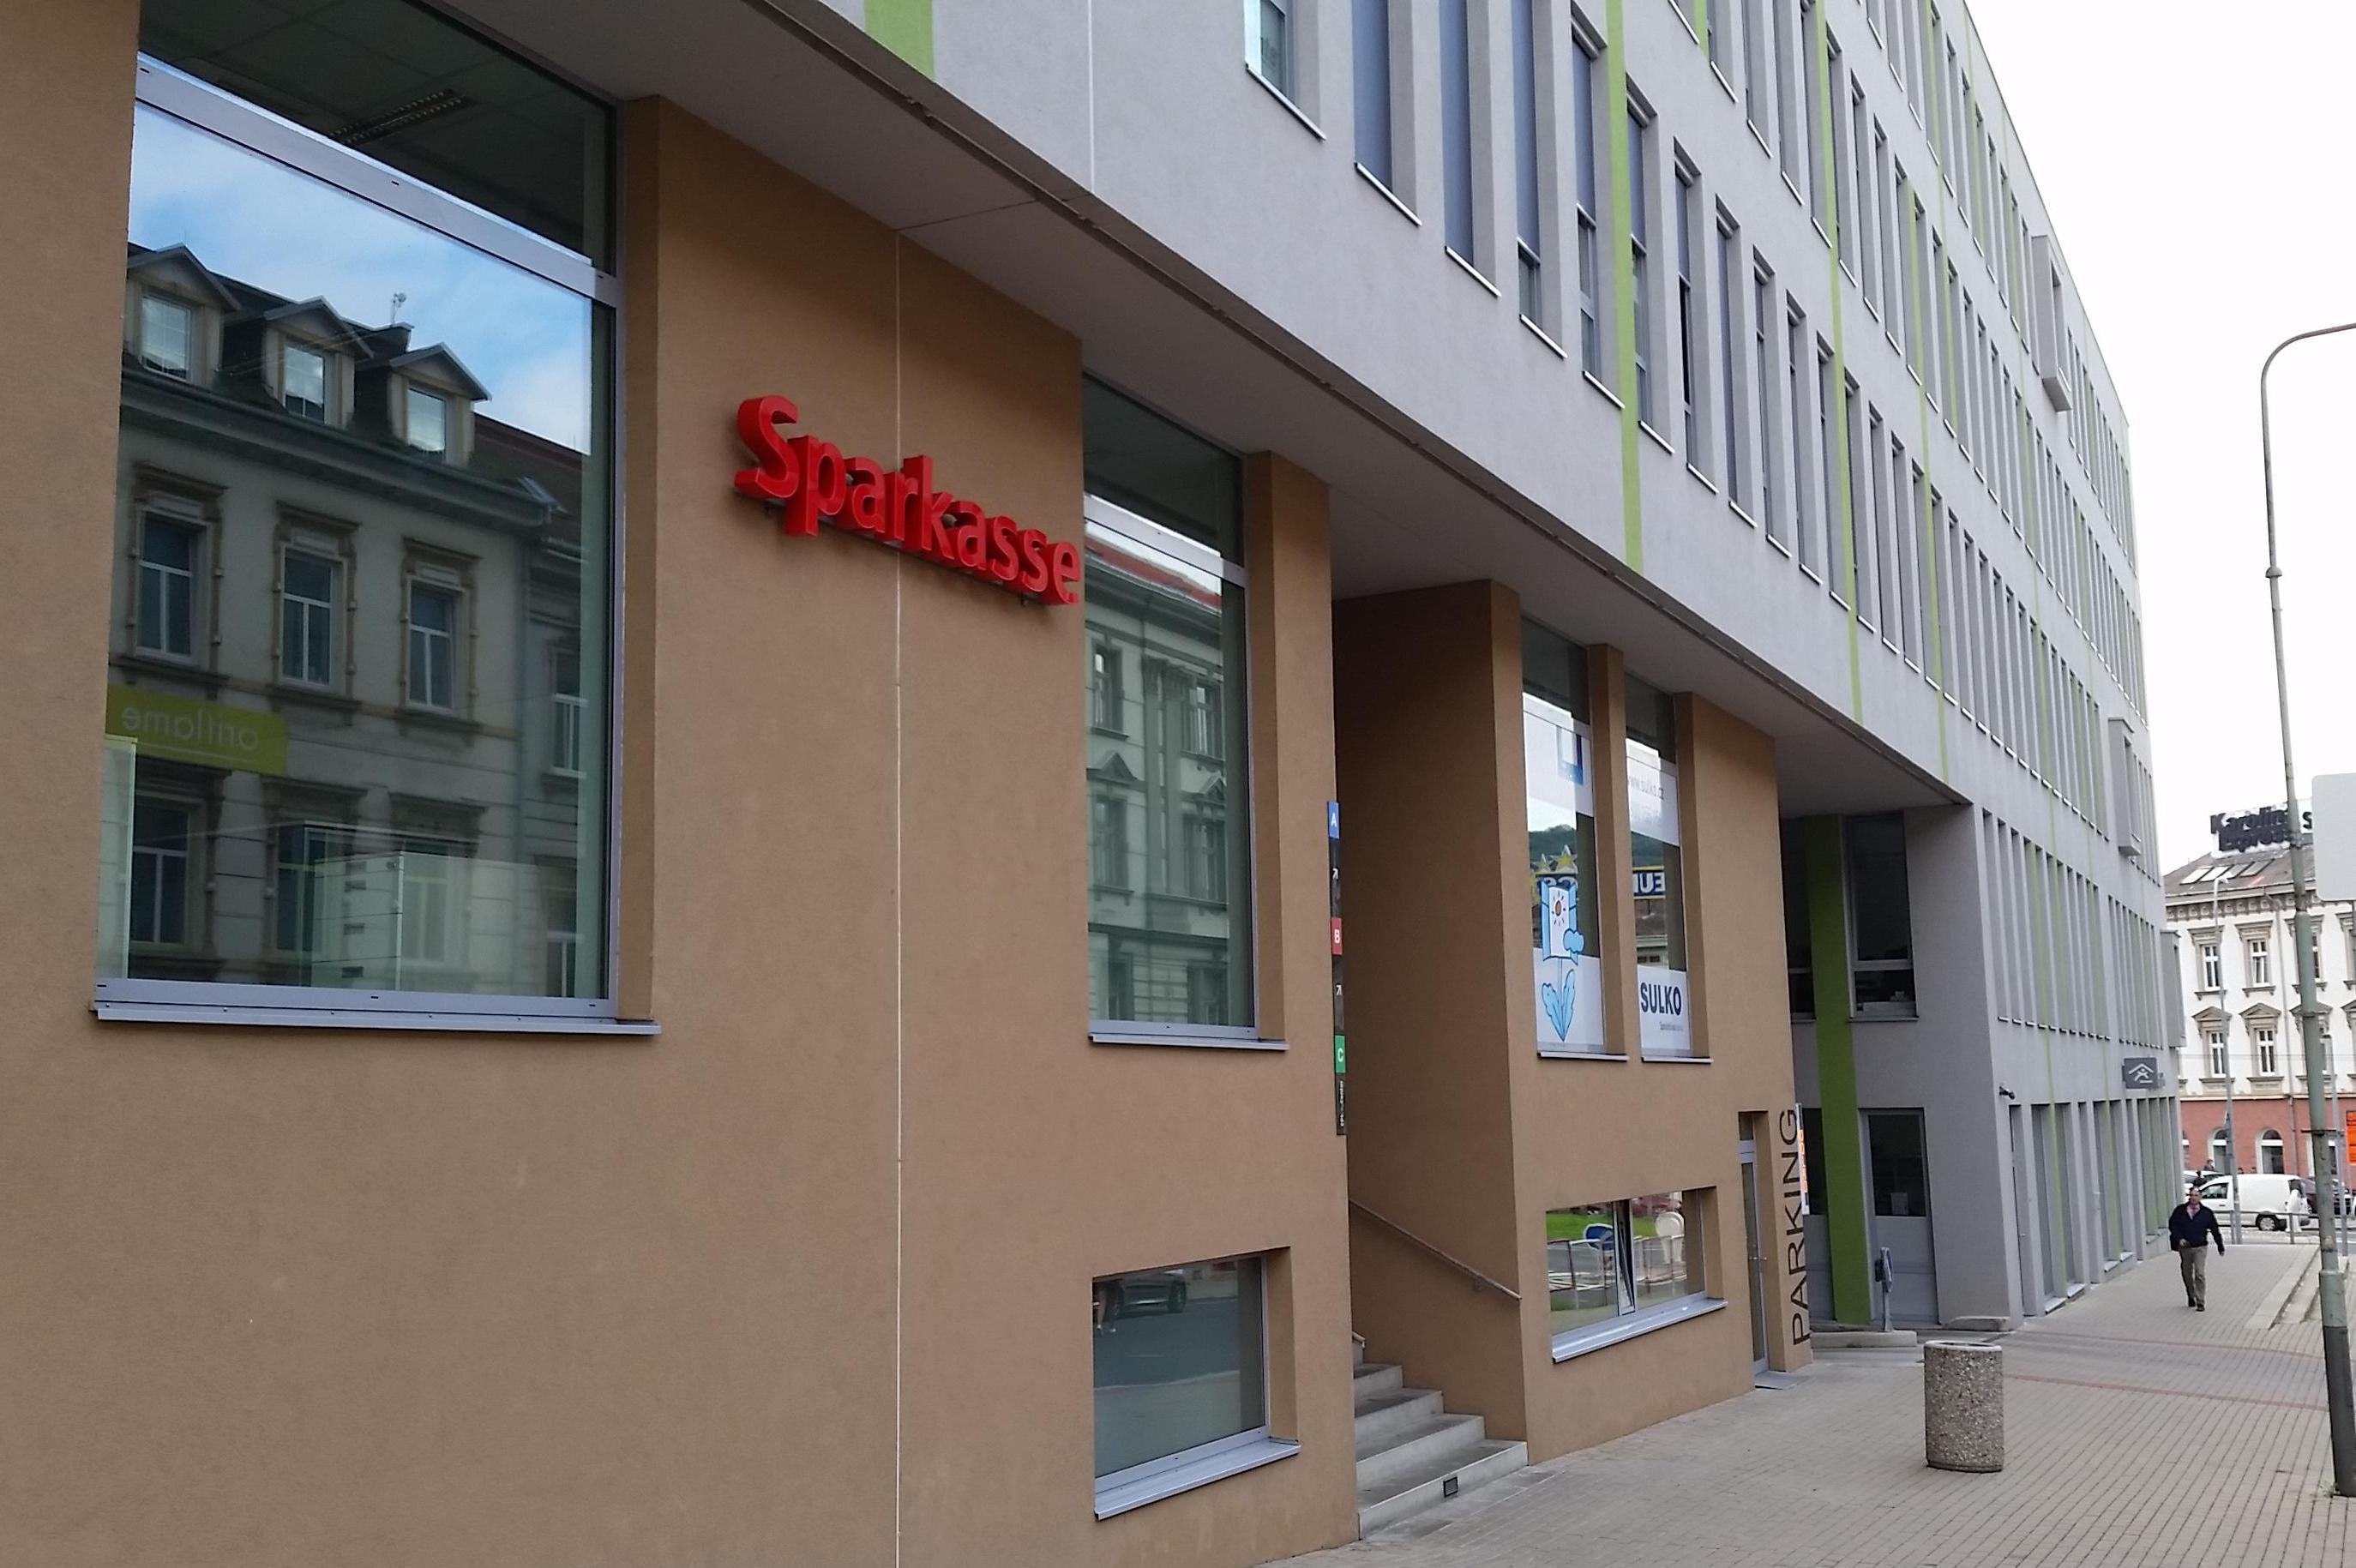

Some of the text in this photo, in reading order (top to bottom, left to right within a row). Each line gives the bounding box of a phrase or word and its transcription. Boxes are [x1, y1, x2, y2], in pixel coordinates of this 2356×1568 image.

[734, 394, 1080, 604] Sparkasse
[1330, 814, 1337, 827] A
[1333, 928, 1341, 943] B
[1640, 982, 1682, 1016] SULKO
[1337, 1048, 1344, 1062] C
[1779, 1108, 1810, 1346] PARKING
